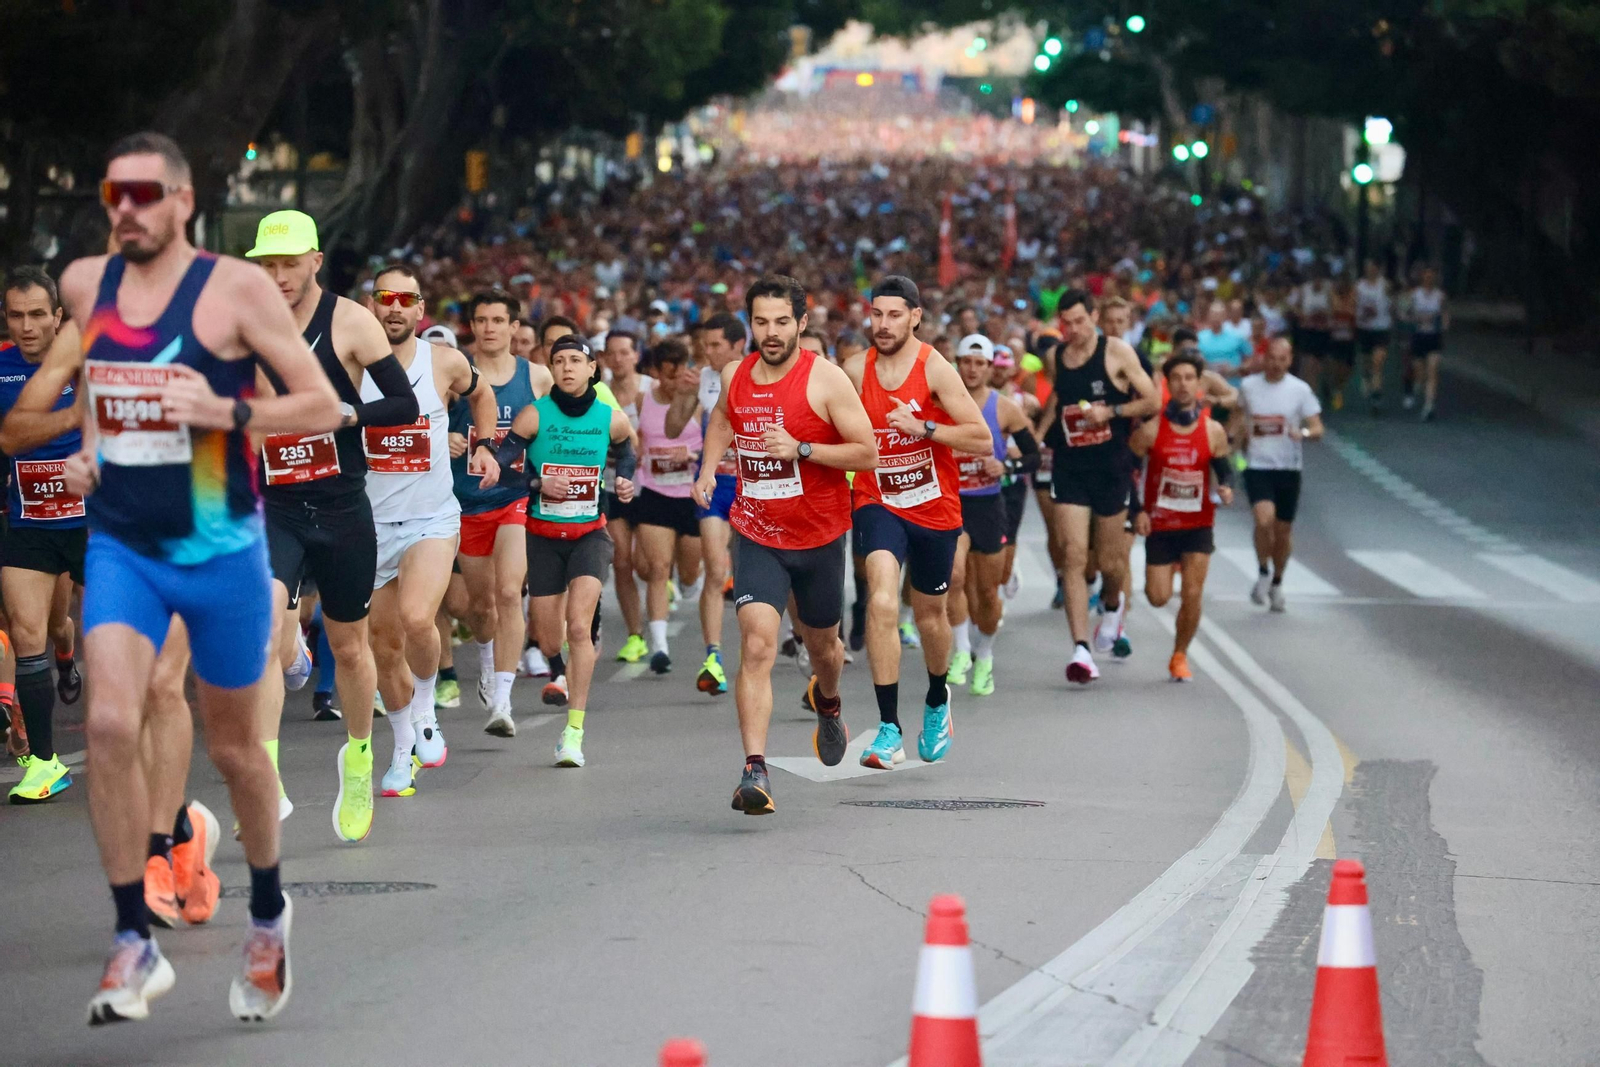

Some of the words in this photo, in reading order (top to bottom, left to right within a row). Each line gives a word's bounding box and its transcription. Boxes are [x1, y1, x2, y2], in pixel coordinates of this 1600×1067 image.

[263, 223, 289, 236] ciele
[496, 405, 512, 418] AR
[742, 406, 773, 414] GENERALI
[380, 436, 413, 447] 4835
[746, 440, 767, 451] GENE
[279, 444, 315, 461] 2351
[286, 458, 311, 466] VALENTIN
[887, 452, 928, 467] GENERALI
[33, 463, 67, 474] GENERA
[746, 459, 782, 472] 17644
[557, 468, 596, 477] GENERALI
[887, 470, 924, 485] 13496
[33, 482, 65, 494] 2412
[567, 484, 588, 495] 534
